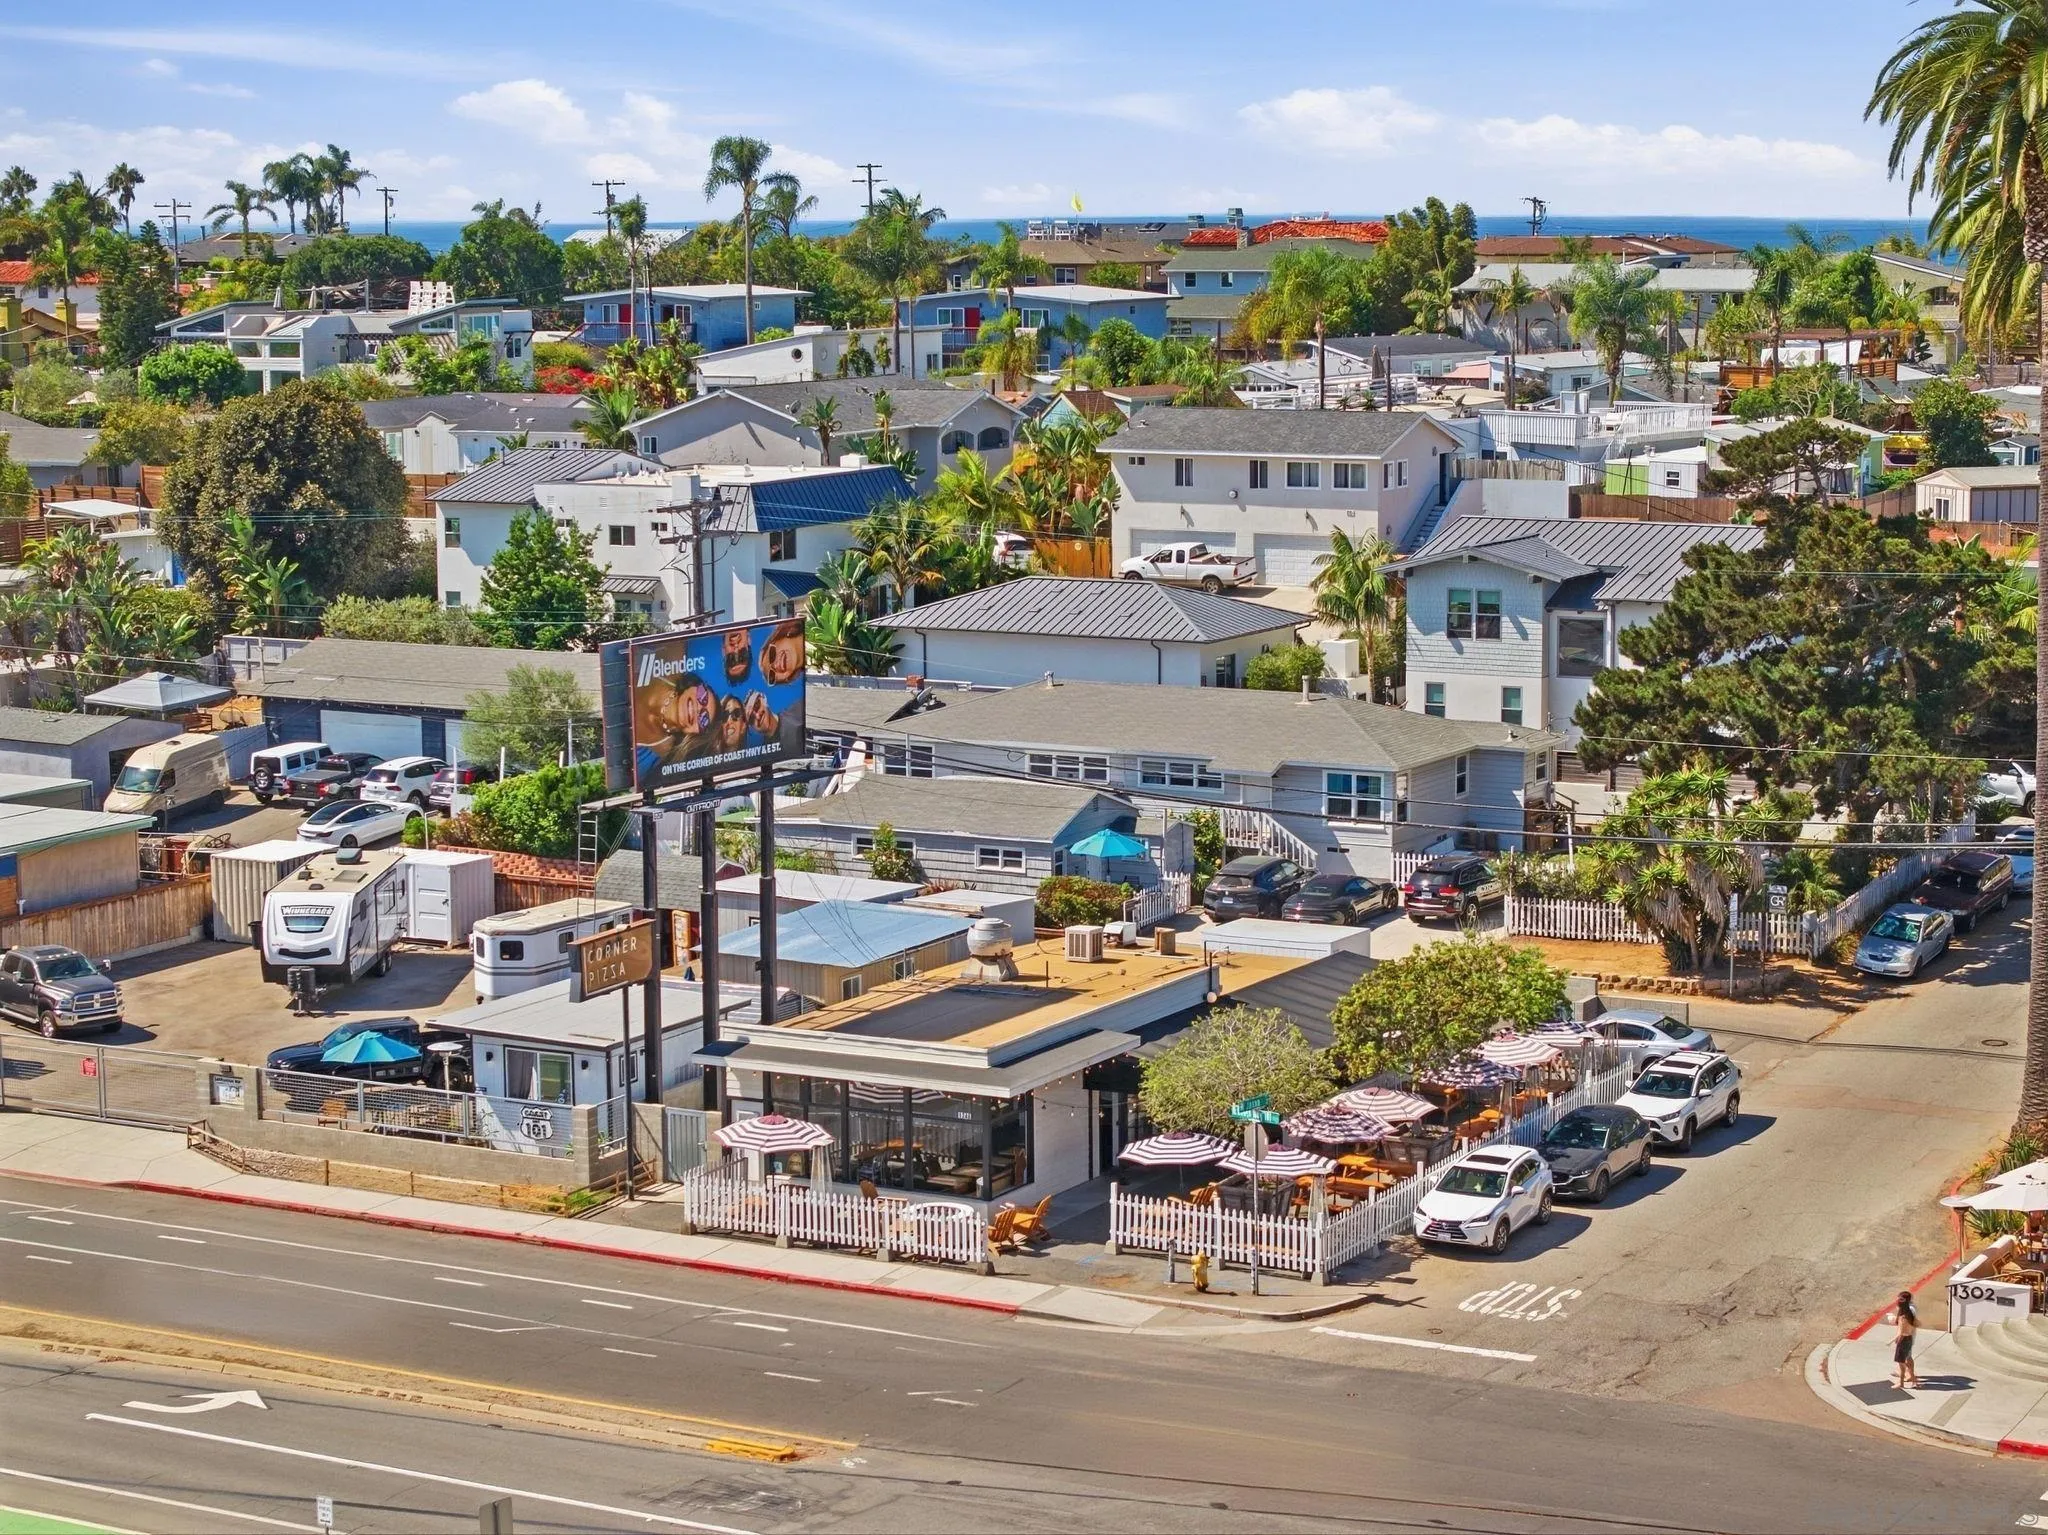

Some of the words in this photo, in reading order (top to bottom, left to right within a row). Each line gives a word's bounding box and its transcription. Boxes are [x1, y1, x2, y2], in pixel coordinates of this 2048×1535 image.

[652, 653, 705, 678] Blenders
[661, 765, 672, 776] ON
[672, 763, 687, 774] THE
[686, 756, 714, 772] CORNER
[713, 753, 724, 765] OF
[723, 749, 745, 763] COAST
[745, 746, 761, 759] HWY
[587, 936, 637, 964] CORNER
[588, 961, 626, 985] PIZZA
[525, 1122, 547, 1140] 101
[1457, 1280, 1583, 1322] STOP
[1953, 1284, 1995, 1301] 1302
